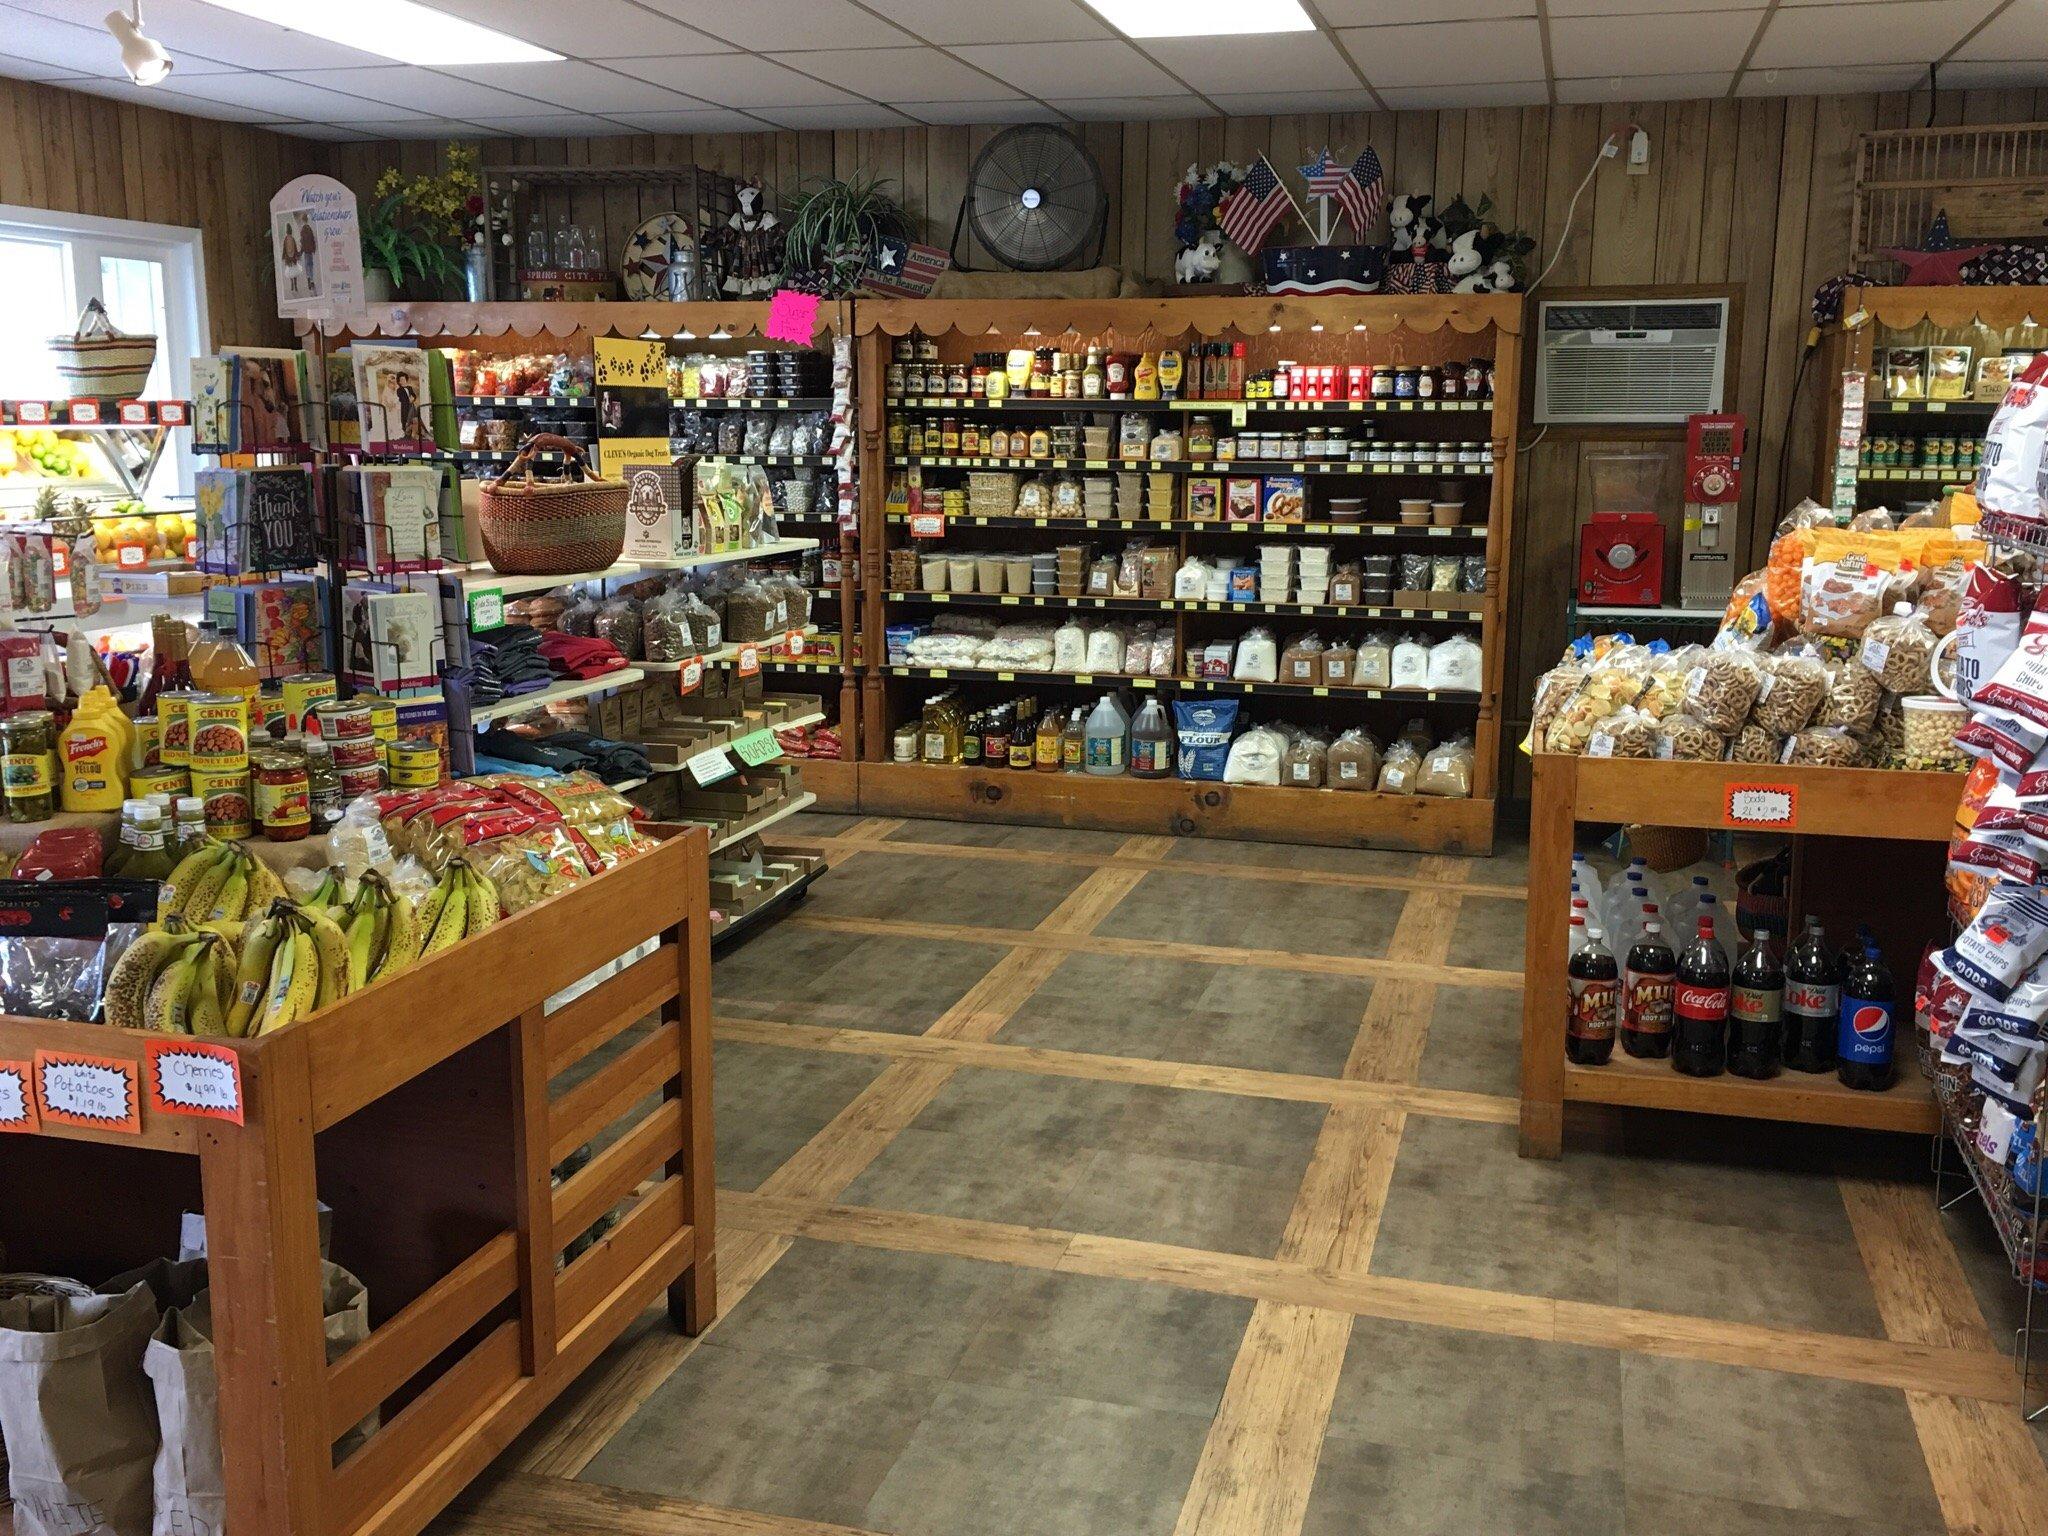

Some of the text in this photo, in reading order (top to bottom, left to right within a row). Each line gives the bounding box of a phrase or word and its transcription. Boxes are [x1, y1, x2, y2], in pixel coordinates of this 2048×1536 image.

[911, 252, 945, 267] America
[527, 271, 557, 279] SPRING
[879, 274, 893, 285] The
[258, 493, 300, 520] thank
[264, 519, 294, 549] YOU
[1846, 551, 1867, 561] Good
[200, 710, 237, 718] CENTO
[1180, 736, 1221, 744] FLOUR
[69, 738, 105, 755] French's
[738, 734, 777, 762] SOAPS!
[193, 757, 221, 765] KIDNEY
[74, 764, 102, 774] YELLOW
[208, 778, 246, 788] CENTO
[1744, 793, 1766, 804] Soda
[1985, 951, 2010, 970] CHIPS
[1636, 985, 1671, 1004] MU
[1681, 990, 1727, 1009] Coca-Cola
[1583, 991, 1615, 1013] MU
[2007, 995, 2031, 1009] CHIPS
[1589, 1020, 1605, 1028] ROOT
[1855, 1043, 1885, 1055] pepsi
[173, 1060, 225, 1080] Cherries
[53, 1074, 115, 1099] Potatoes
[219, 1088, 229, 1100] lb
[97, 1100, 107, 1111] lb
